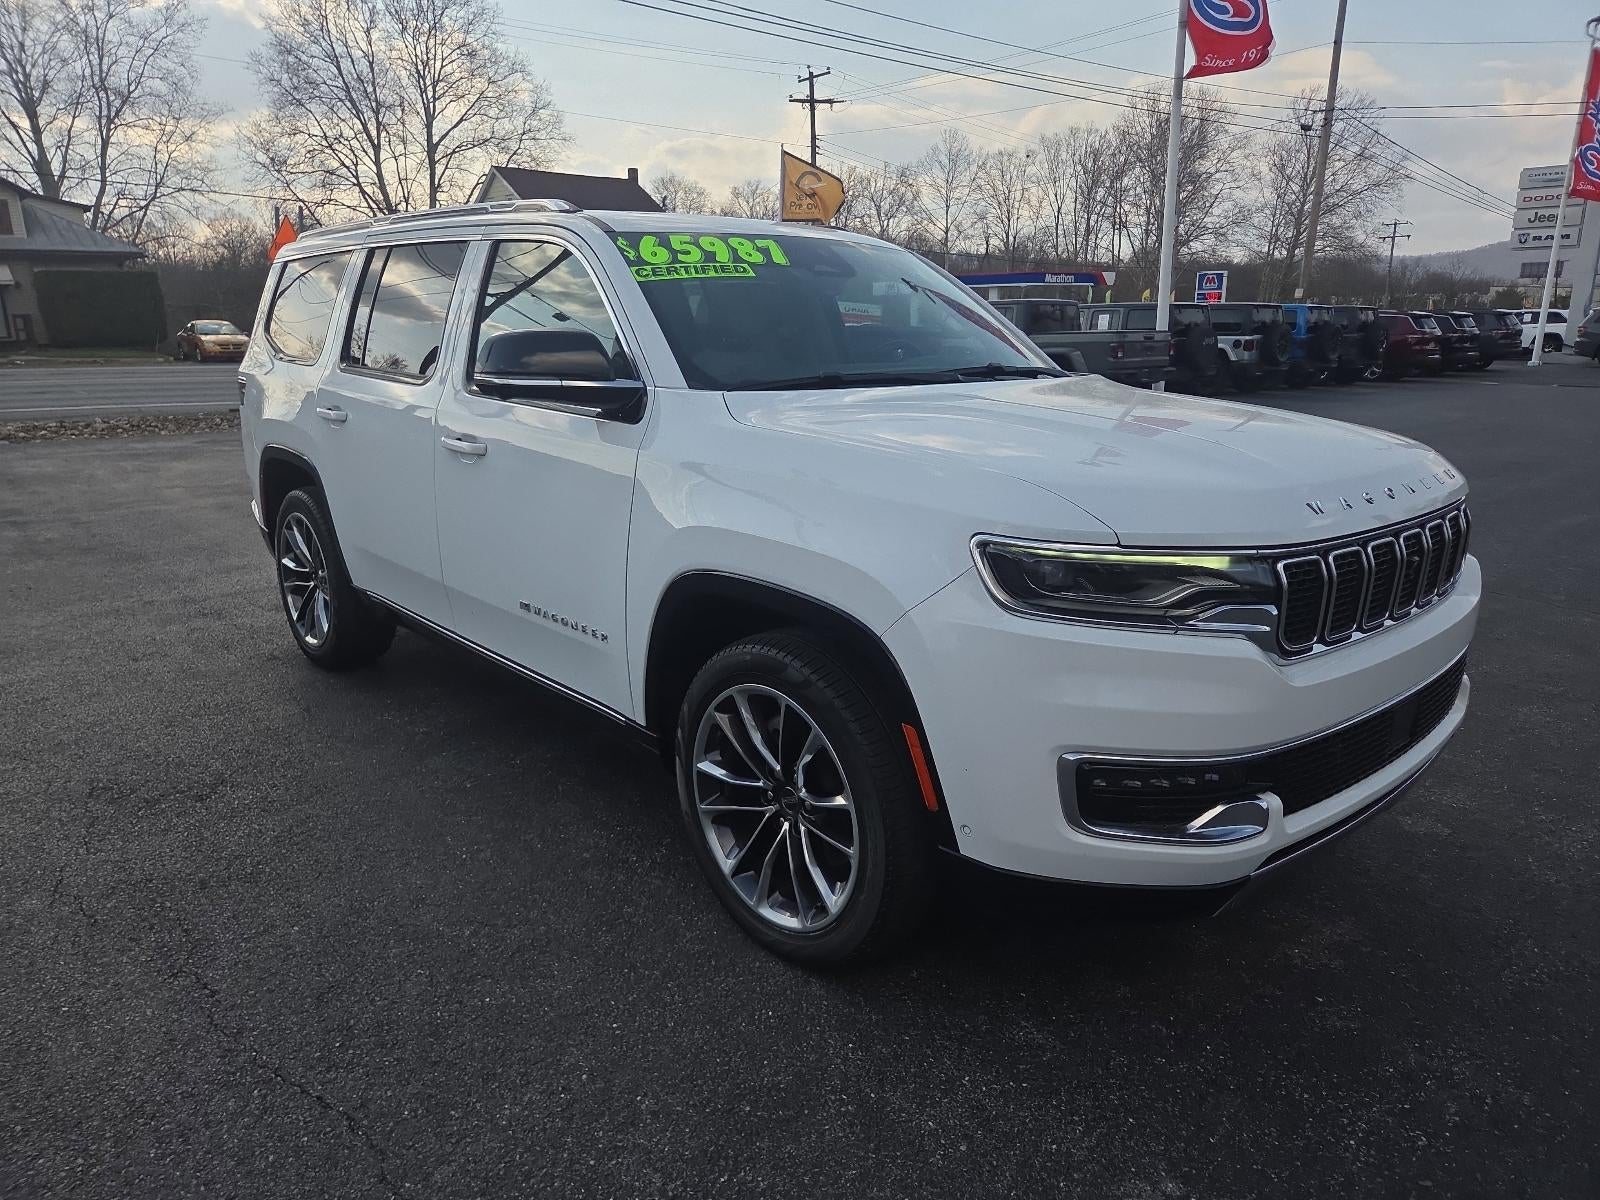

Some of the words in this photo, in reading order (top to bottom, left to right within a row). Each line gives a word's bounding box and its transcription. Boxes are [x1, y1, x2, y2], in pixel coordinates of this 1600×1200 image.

[1201, 53, 1235, 67] Since
[1240, 46, 1263, 64] 197
[1523, 194, 1562, 202] DODG
[617, 233, 790, 265] $65987
[634, 264, 750, 279] CERTIFIED
[1044, 273, 1075, 283] Marathon
[1305, 468, 1456, 516] WAGONEER
[533, 604, 609, 643] WAGONEER
